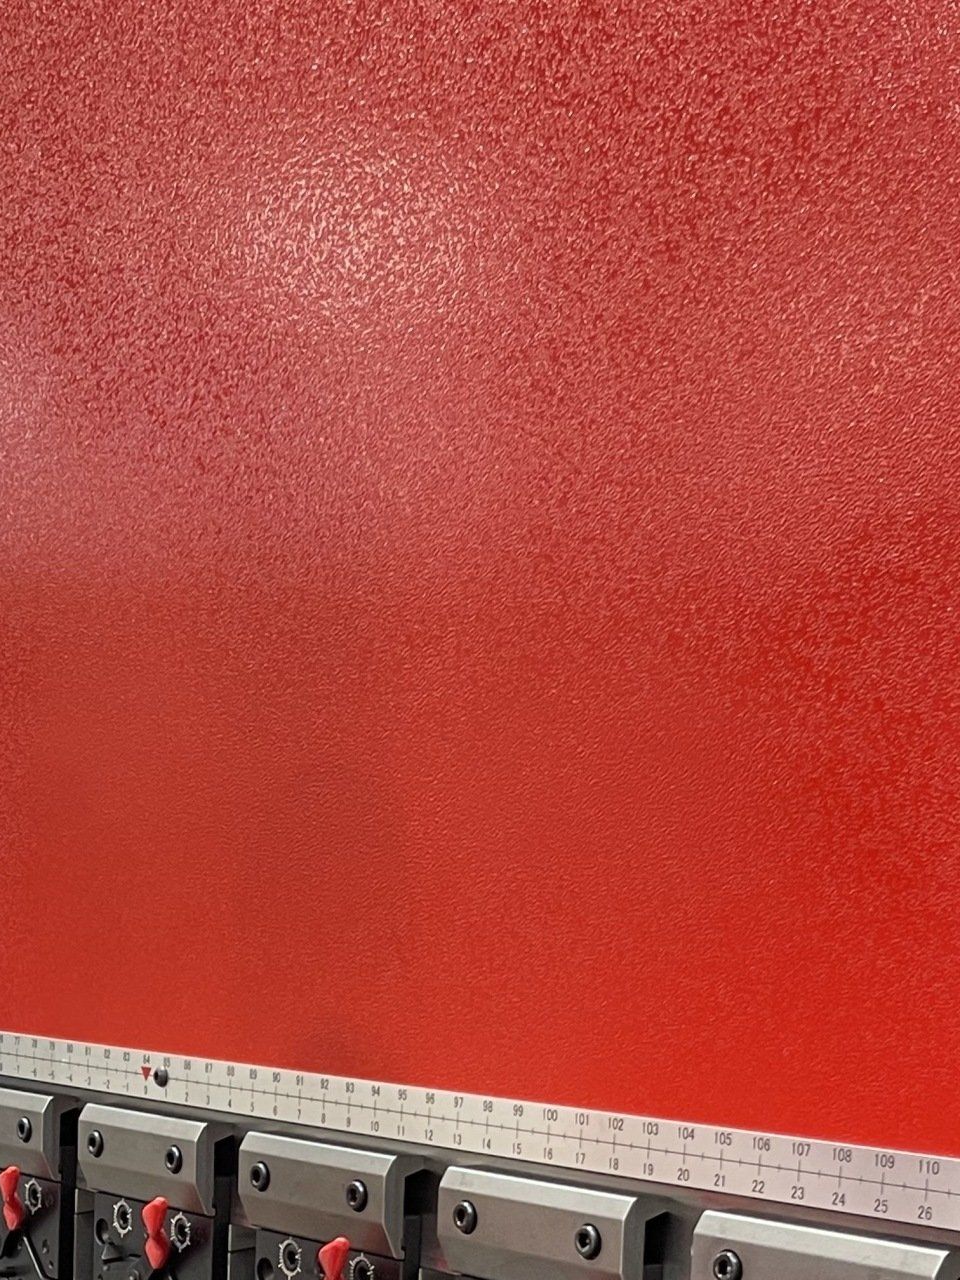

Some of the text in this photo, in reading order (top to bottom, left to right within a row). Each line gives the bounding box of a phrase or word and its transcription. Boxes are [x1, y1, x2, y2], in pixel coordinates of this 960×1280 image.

[184, 1091, 189, 1102] 2
[206, 1095, 211, 1106] 3
[227, 1099, 232, 1108] 4
[250, 1102, 255, 1113] 5
[273, 1105, 278, 1116] 6
[297, 1109, 302, 1120] 7
[320, 1113, 326, 1124] 8
[346, 1116, 352, 1128] 9
[370, 1120, 379, 1133] 10
[397, 1125, 405, 1137] 11
[424, 1129, 433, 1141] 12
[453, 1133, 462, 1146] 13
[482, 1137, 491, 1150] 14
[512, 1142, 522, 1155] 15
[543, 1147, 553, 1161] 16
[575, 1152, 586, 1165] 17
[608, 1157, 619, 1171] 18
[642, 1162, 654, 1176] 19
[677, 1168, 690, 1182] 20
[714, 1173, 725, 1187] 21
[752, 1179, 765, 1194] 22
[791, 1185, 805, 1200] 23
[831, 1192, 845, 1207] 24
[873, 1199, 888, 1214] 25
[917, 1205, 933, 1221] 26
[249, 1069, 258, 1080] 89
[272, 1071, 281, 1083] 90
[296, 1075, 304, 1086] 91
[320, 1079, 329, 1090] 92
[345, 1082, 355, 1094] 93
[371, 1085, 381, 1097] 94
[398, 1089, 407, 1101] 95
[425, 1092, 435, 1105] 96
[453, 1096, 464, 1108] 97
[483, 1100, 493, 1113] 98
[512, 1104, 524, 1117] 99
[542, 1108, 558, 1122] 100
[574, 1113, 590, 1126] 101
[607, 1117, 624, 1132] 102
[642, 1122, 659, 1136] 103
[677, 1126, 695, 1141] 104
[714, 1131, 733, 1146] 105
[752, 1136, 771, 1152] 106
[791, 1142, 811, 1157] 107
[831, 1148, 852, 1163] 108
[874, 1153, 895, 1169] 109
[918, 1160, 940, 1176] 110
